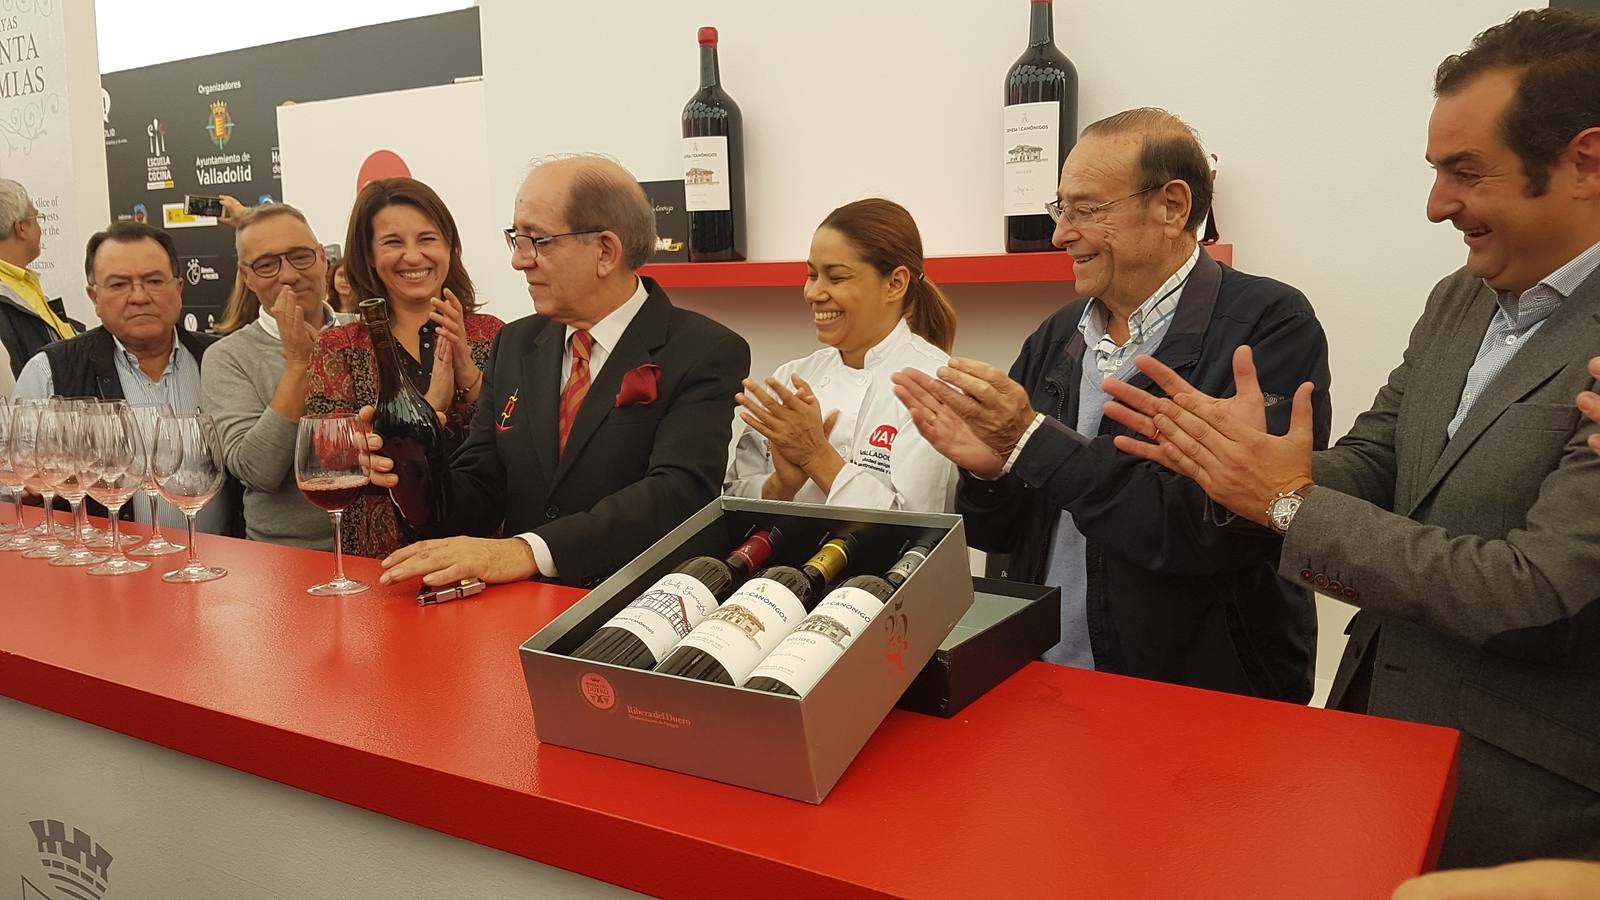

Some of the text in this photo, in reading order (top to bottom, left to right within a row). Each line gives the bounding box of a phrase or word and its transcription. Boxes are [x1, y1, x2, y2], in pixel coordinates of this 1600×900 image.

[198, 80, 242, 95] Organizadores
[146, 155, 171, 167] ESCUELA
[196, 152, 251, 168] Ayuntamiento de
[147, 169, 172, 182] COCINA
[196, 164, 253, 186] Valladolid
[51, 196, 59, 207] of
[49, 225, 60, 236] the
[872, 430, 895, 445] VA!
